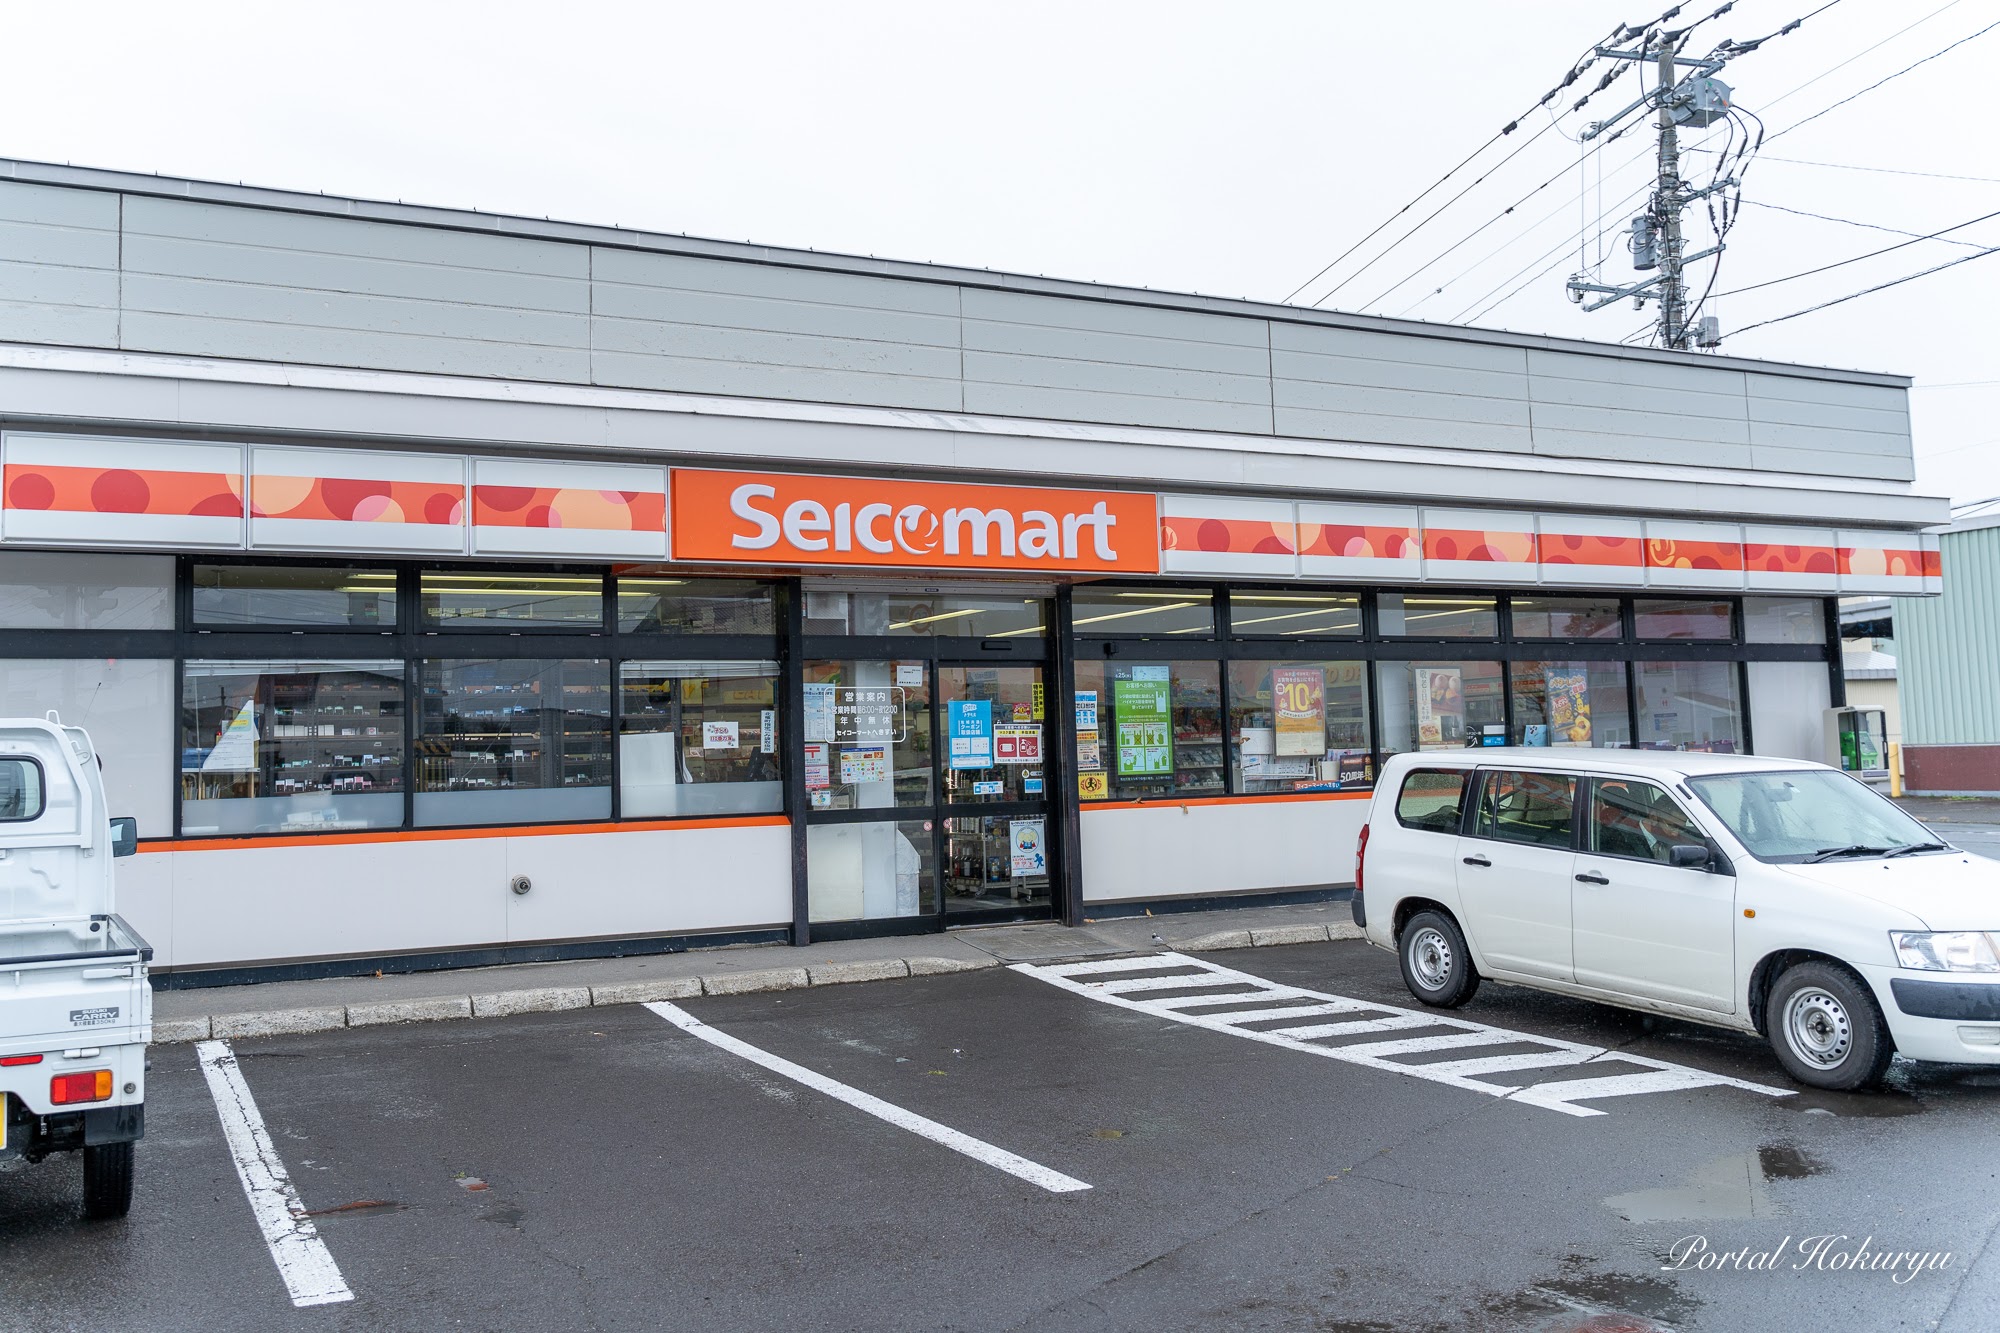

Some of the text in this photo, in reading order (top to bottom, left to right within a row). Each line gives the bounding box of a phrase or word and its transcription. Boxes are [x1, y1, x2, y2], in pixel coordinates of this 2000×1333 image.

[730, 483, 1118, 561] Seicomart
[845, 692, 885, 702] 営業案内
[840, 716, 890, 725] 年中無休
[836, 728, 897, 736] セイコーマートへきすい
[72, 1011, 117, 1021] CARRY
